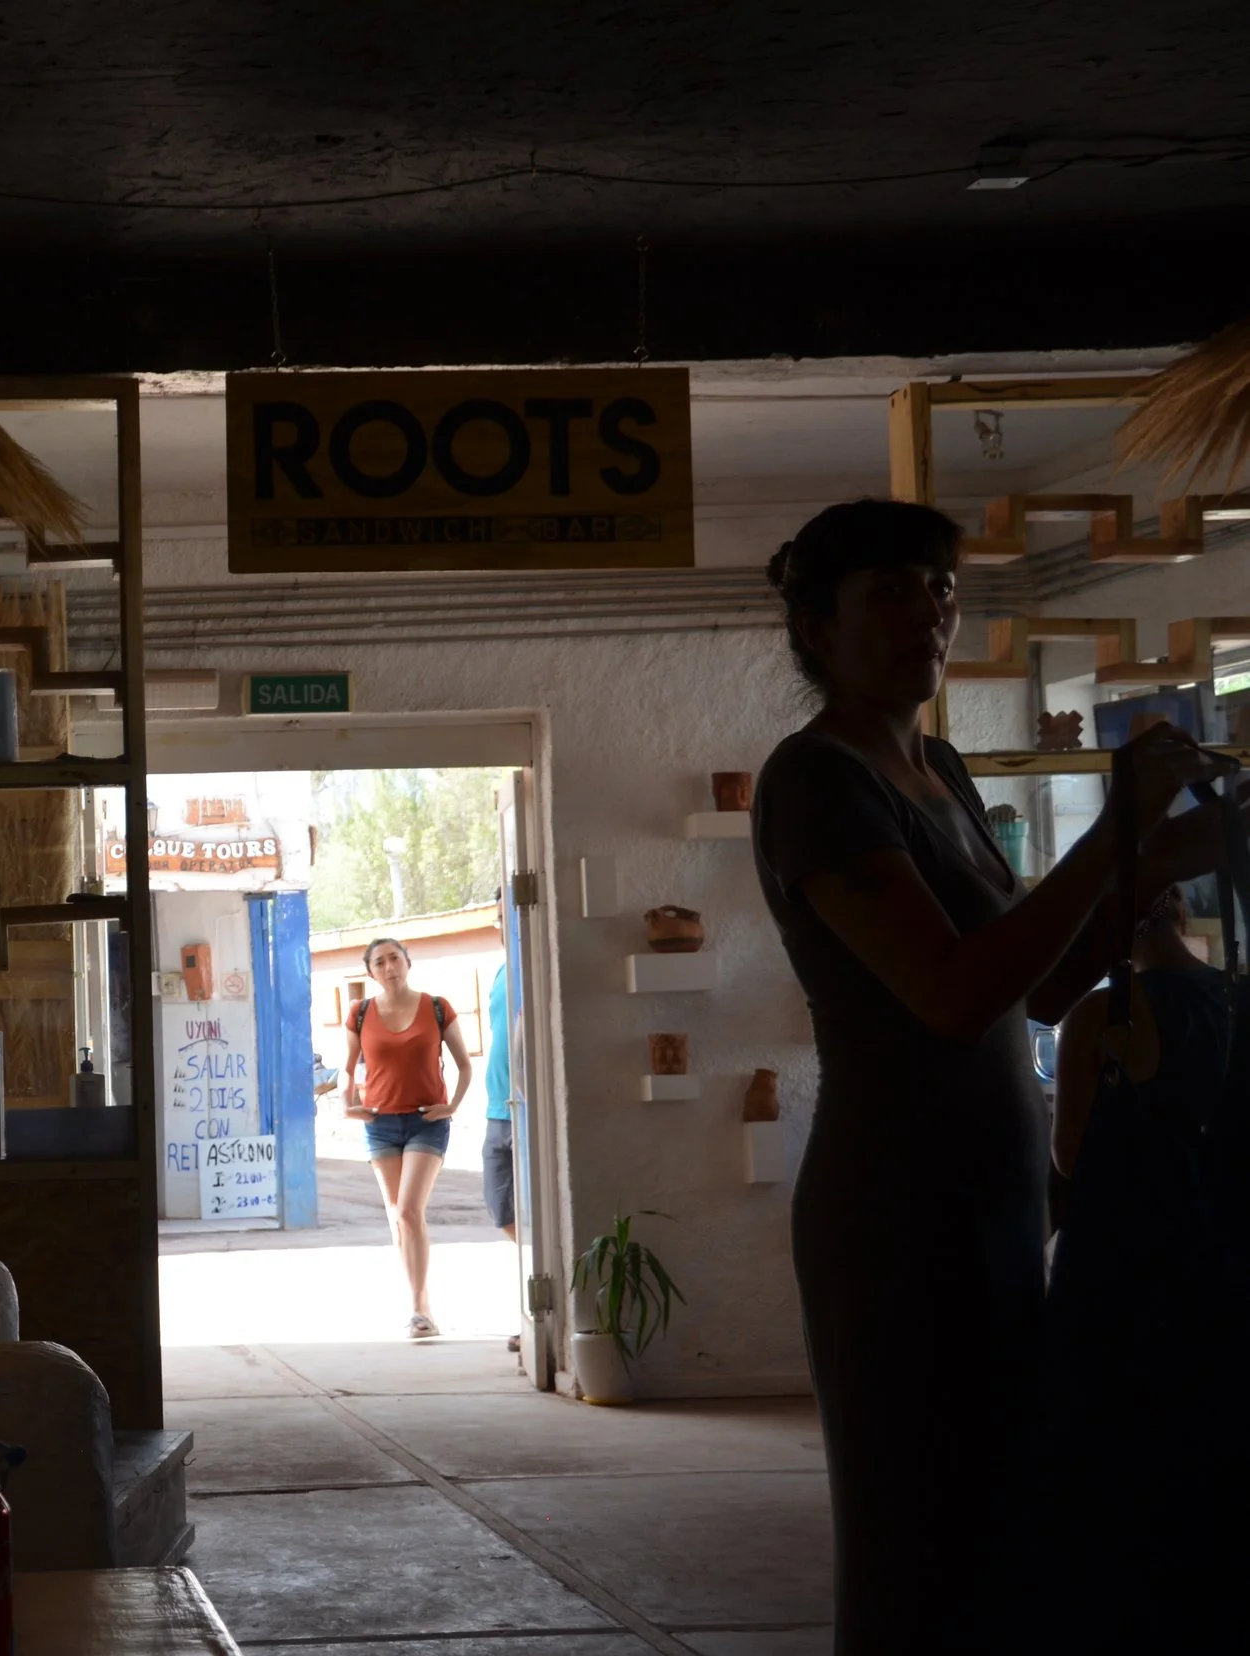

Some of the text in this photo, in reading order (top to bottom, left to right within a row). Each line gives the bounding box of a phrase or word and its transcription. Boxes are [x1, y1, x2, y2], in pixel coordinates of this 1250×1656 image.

[253, 397, 661, 499] ROOTS
[299, 514, 613, 545] SANDWICH BAR
[258, 683, 341, 705] SALIDA
[201, 839, 277, 860] TOURS
[184, 1053, 248, 1081] SALAR
[189, 1087, 205, 1113] 2
[194, 1118, 231, 1140] CON
